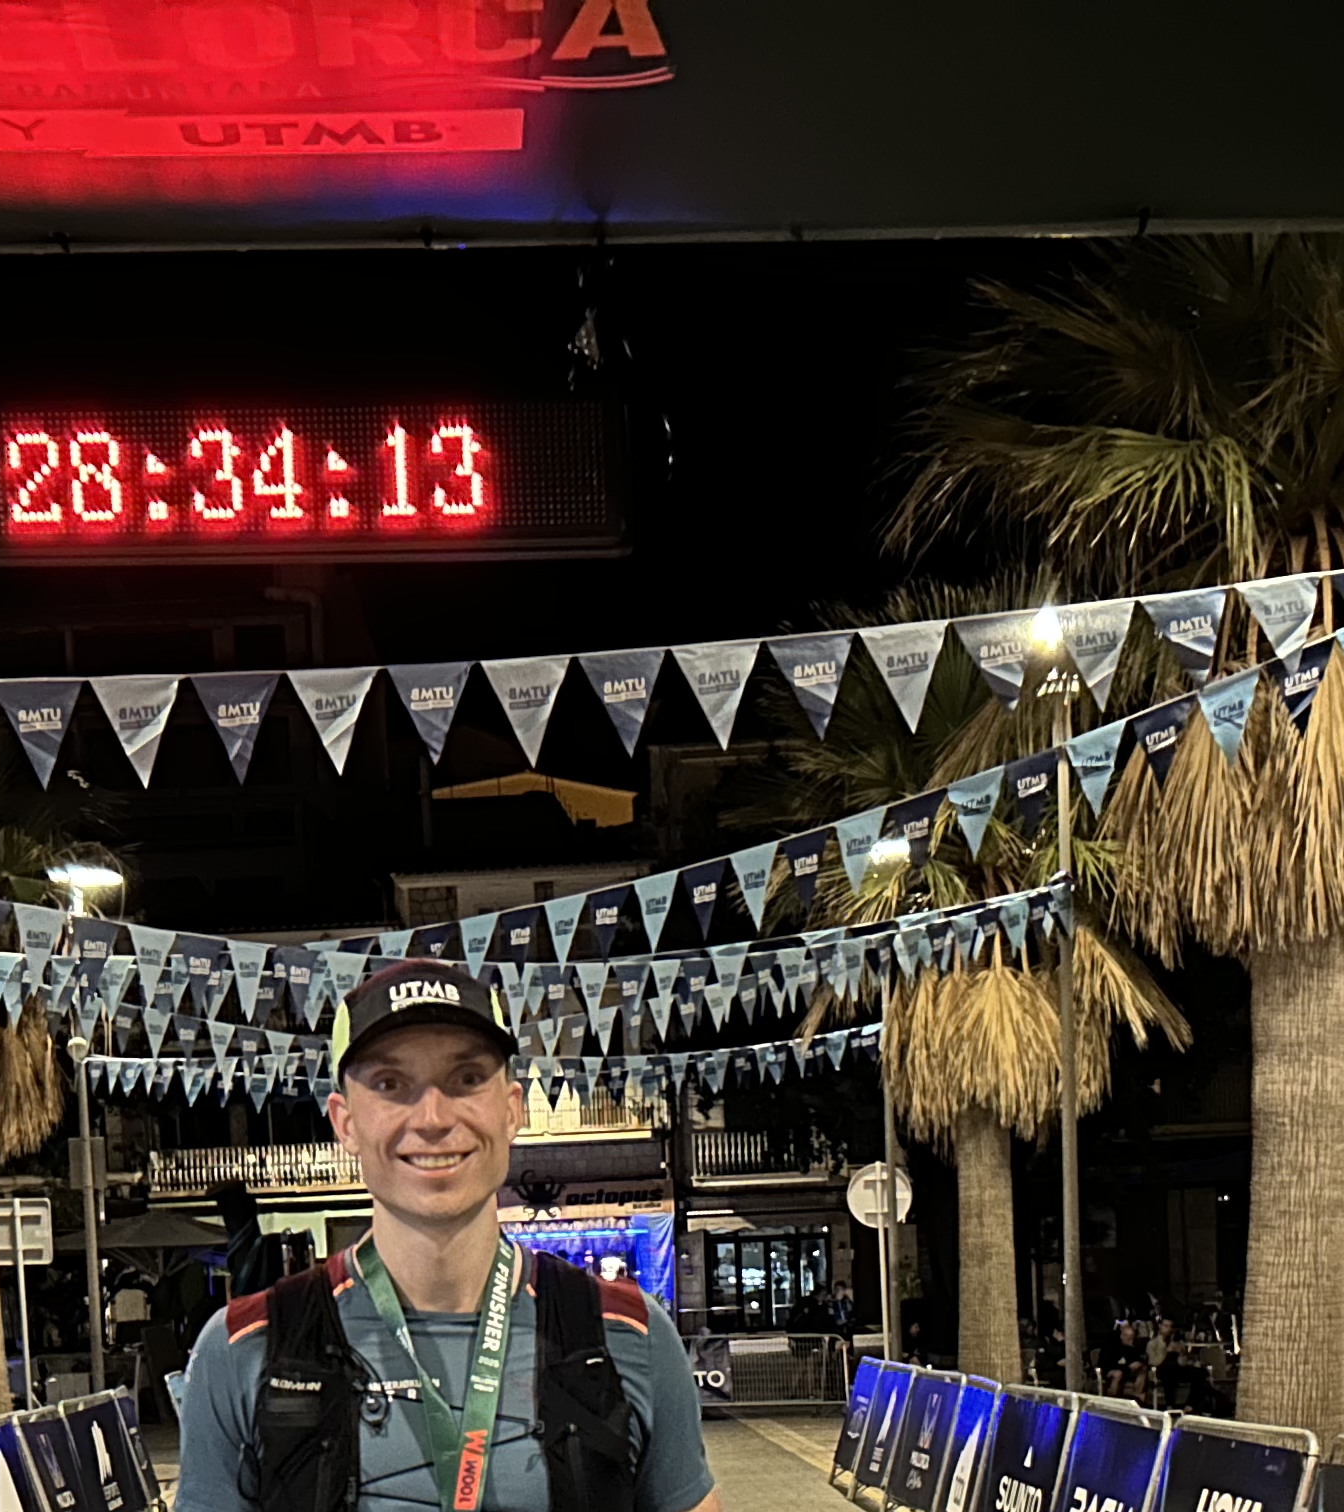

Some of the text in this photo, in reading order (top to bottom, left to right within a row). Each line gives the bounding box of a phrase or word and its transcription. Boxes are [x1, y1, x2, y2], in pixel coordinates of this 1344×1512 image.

[178, 119, 444, 148] UTMB
[6, 423, 488, 523] 28:34:13
[1284, 666, 1320, 689] UTMB
[1145, 725, 1177, 746] UTMB
[1017, 772, 1048, 791] UTMB
[389, 980, 460, 1001] UTMB
[565, 1187, 664, 1207] octopus
[482, 1262, 510, 1352] FINISHER
[459, 1460, 478, 1503] 100M
